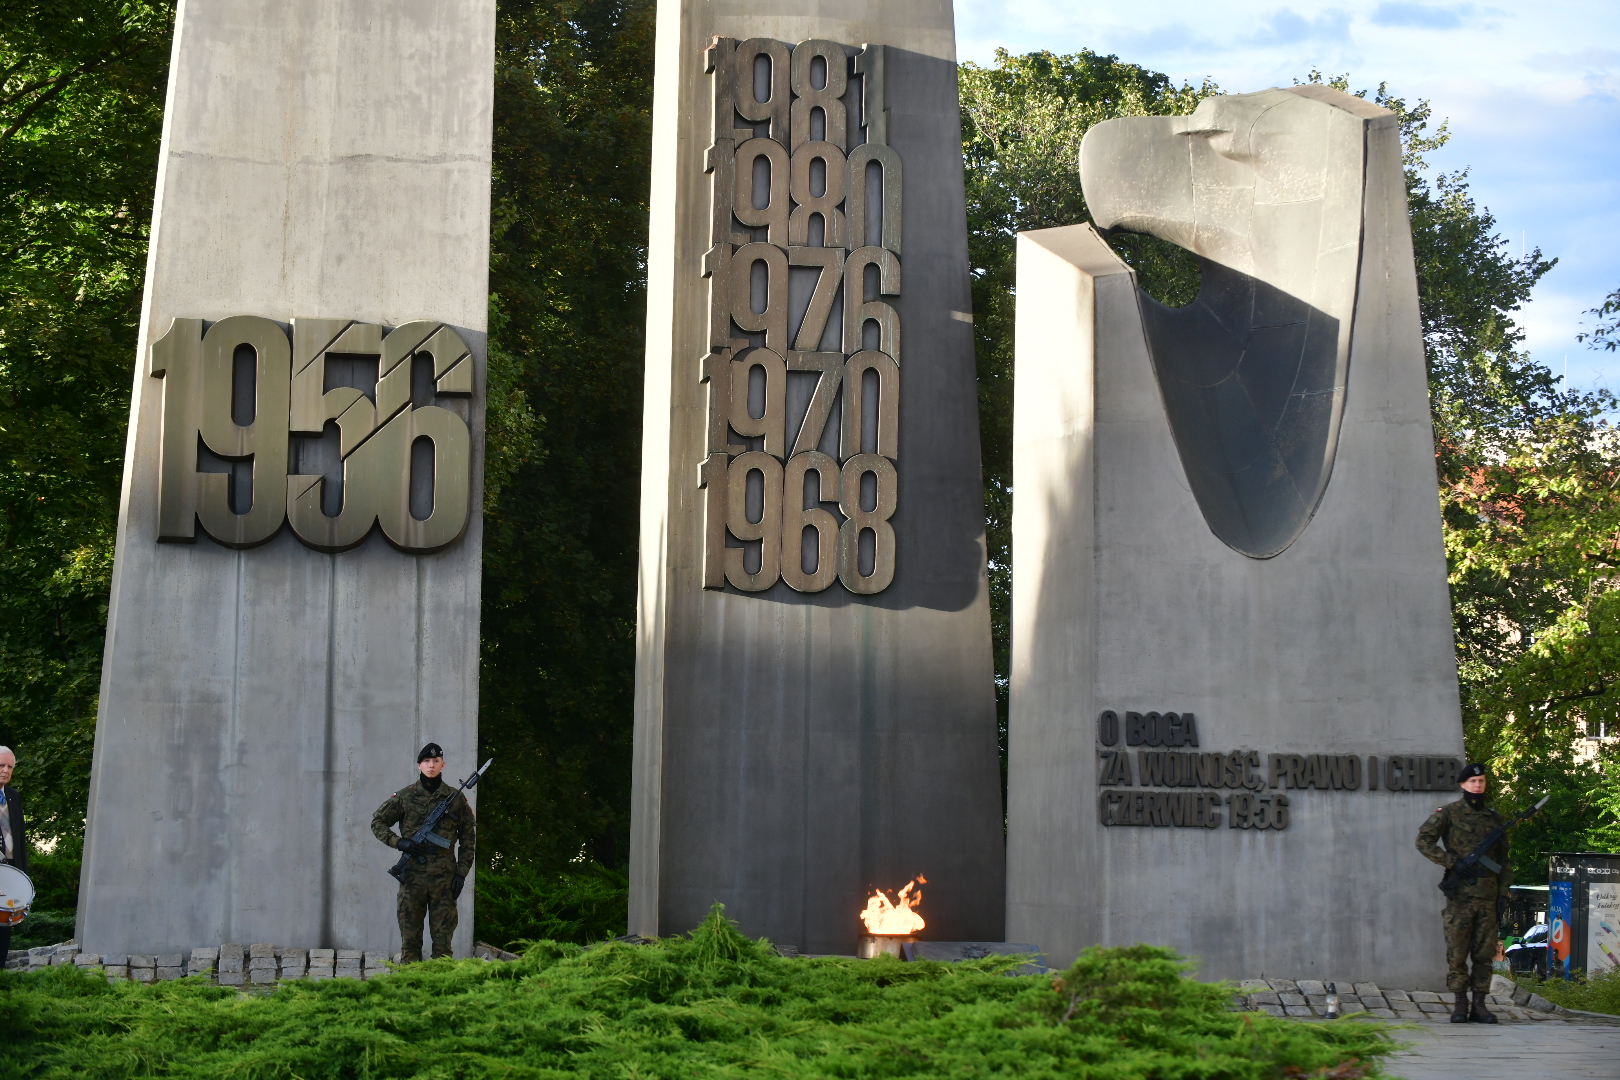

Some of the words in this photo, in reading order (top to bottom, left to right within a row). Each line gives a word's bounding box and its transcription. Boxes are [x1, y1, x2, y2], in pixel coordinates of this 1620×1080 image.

[704, 36, 890, 154] 1981
[703, 138, 902, 252] 1980
[701, 242, 901, 364] 1976
[151, 315, 474, 554] 1956
[699, 346, 900, 460] 1970
[697, 451, 898, 595] 1968
[1100, 710, 1119, 746] O
[1126, 711, 1199, 747] BOGA
[1100, 751, 1132, 786] ZA
[1268, 753, 1362, 791] PRAWO
[1368, 755, 1378, 791] I
[1384, 755, 1463, 792] CHLEB
[1100, 790, 1221, 828] CZERWIEC
[1225, 793, 1289, 830] 1956
